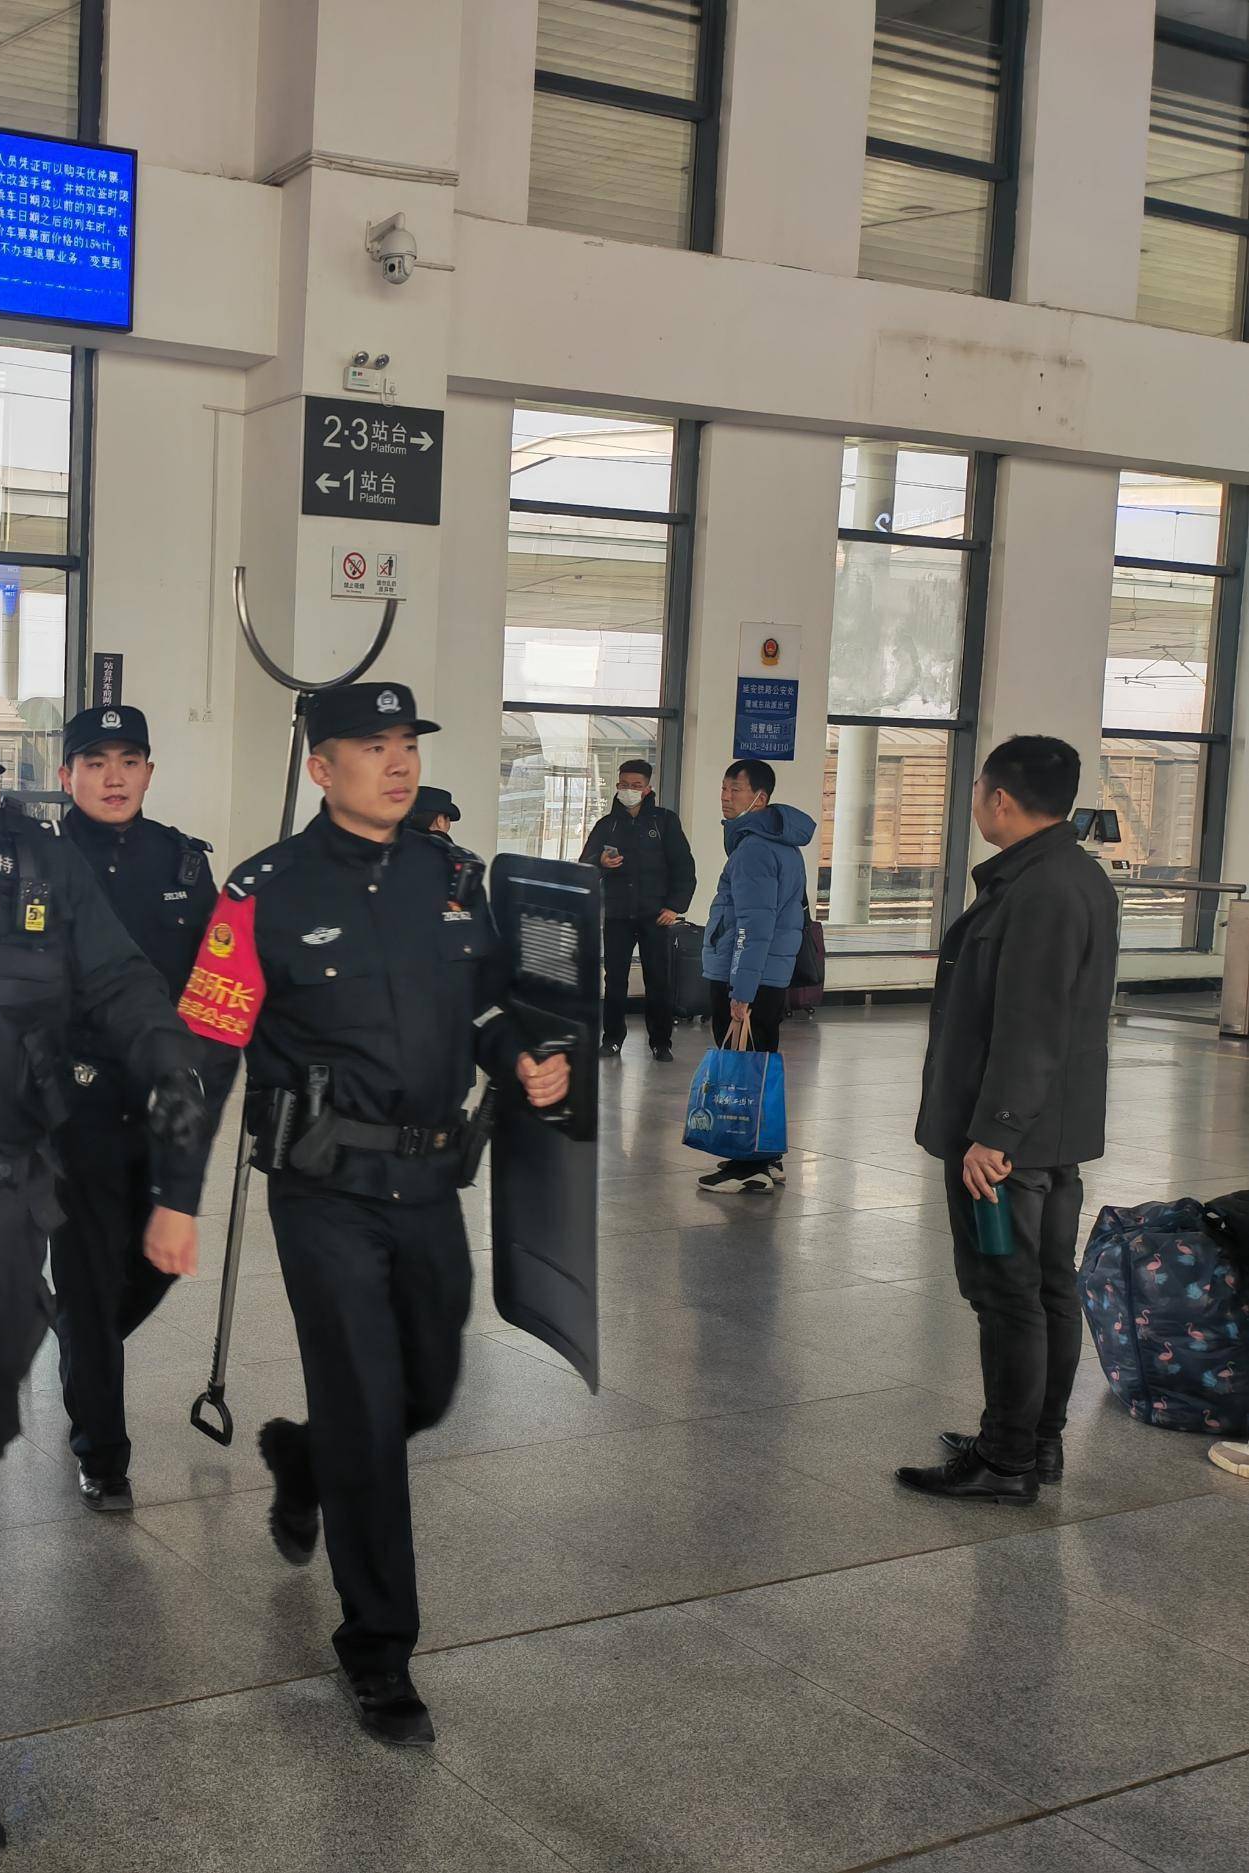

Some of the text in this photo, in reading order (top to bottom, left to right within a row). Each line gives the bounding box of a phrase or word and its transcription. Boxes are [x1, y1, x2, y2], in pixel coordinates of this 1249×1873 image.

[371, 420, 408, 444] 站台
[370, 442, 407, 455] Platform
[343, 469, 355, 501] 1
[360, 470, 396, 494] 站台
[359, 492, 396, 505] Platform
